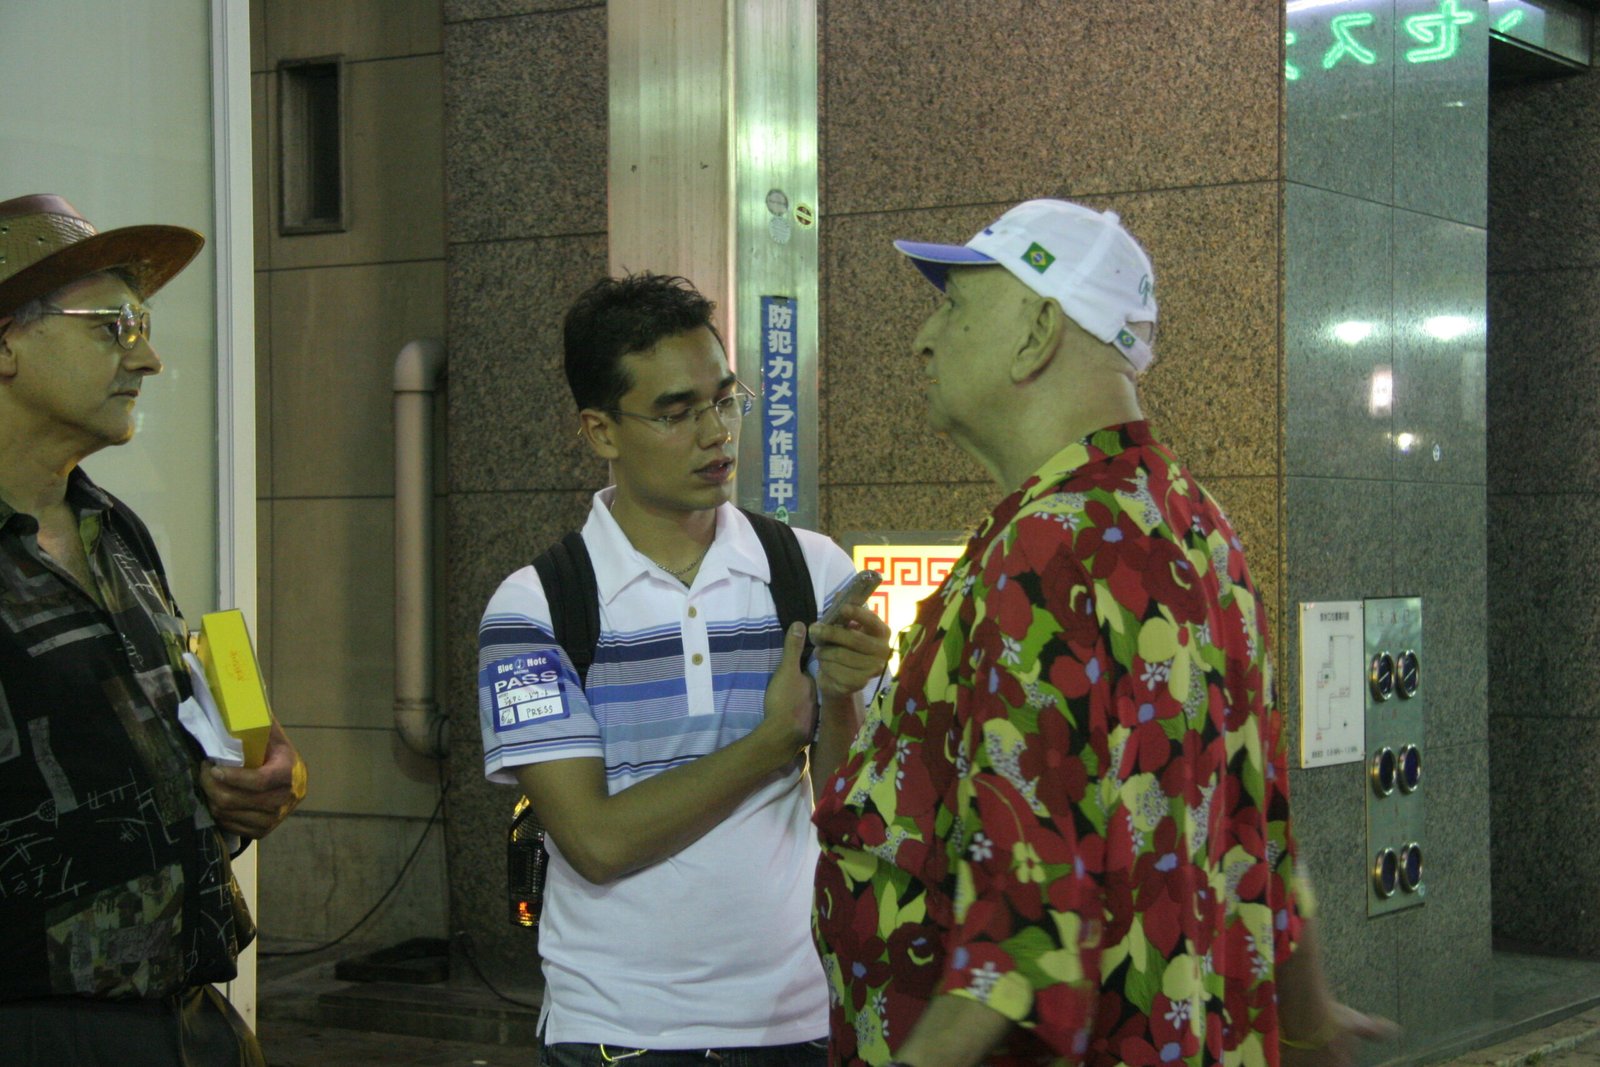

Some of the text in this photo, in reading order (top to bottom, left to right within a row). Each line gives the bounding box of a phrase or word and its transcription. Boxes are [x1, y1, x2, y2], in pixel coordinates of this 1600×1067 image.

[768, 304, 794, 505] 防犯カメラ作動中
[497, 664, 514, 674] Blue
[526, 657, 547, 667] Note
[494, 671, 558, 693] PASS
[526, 705, 553, 718] PRESS
